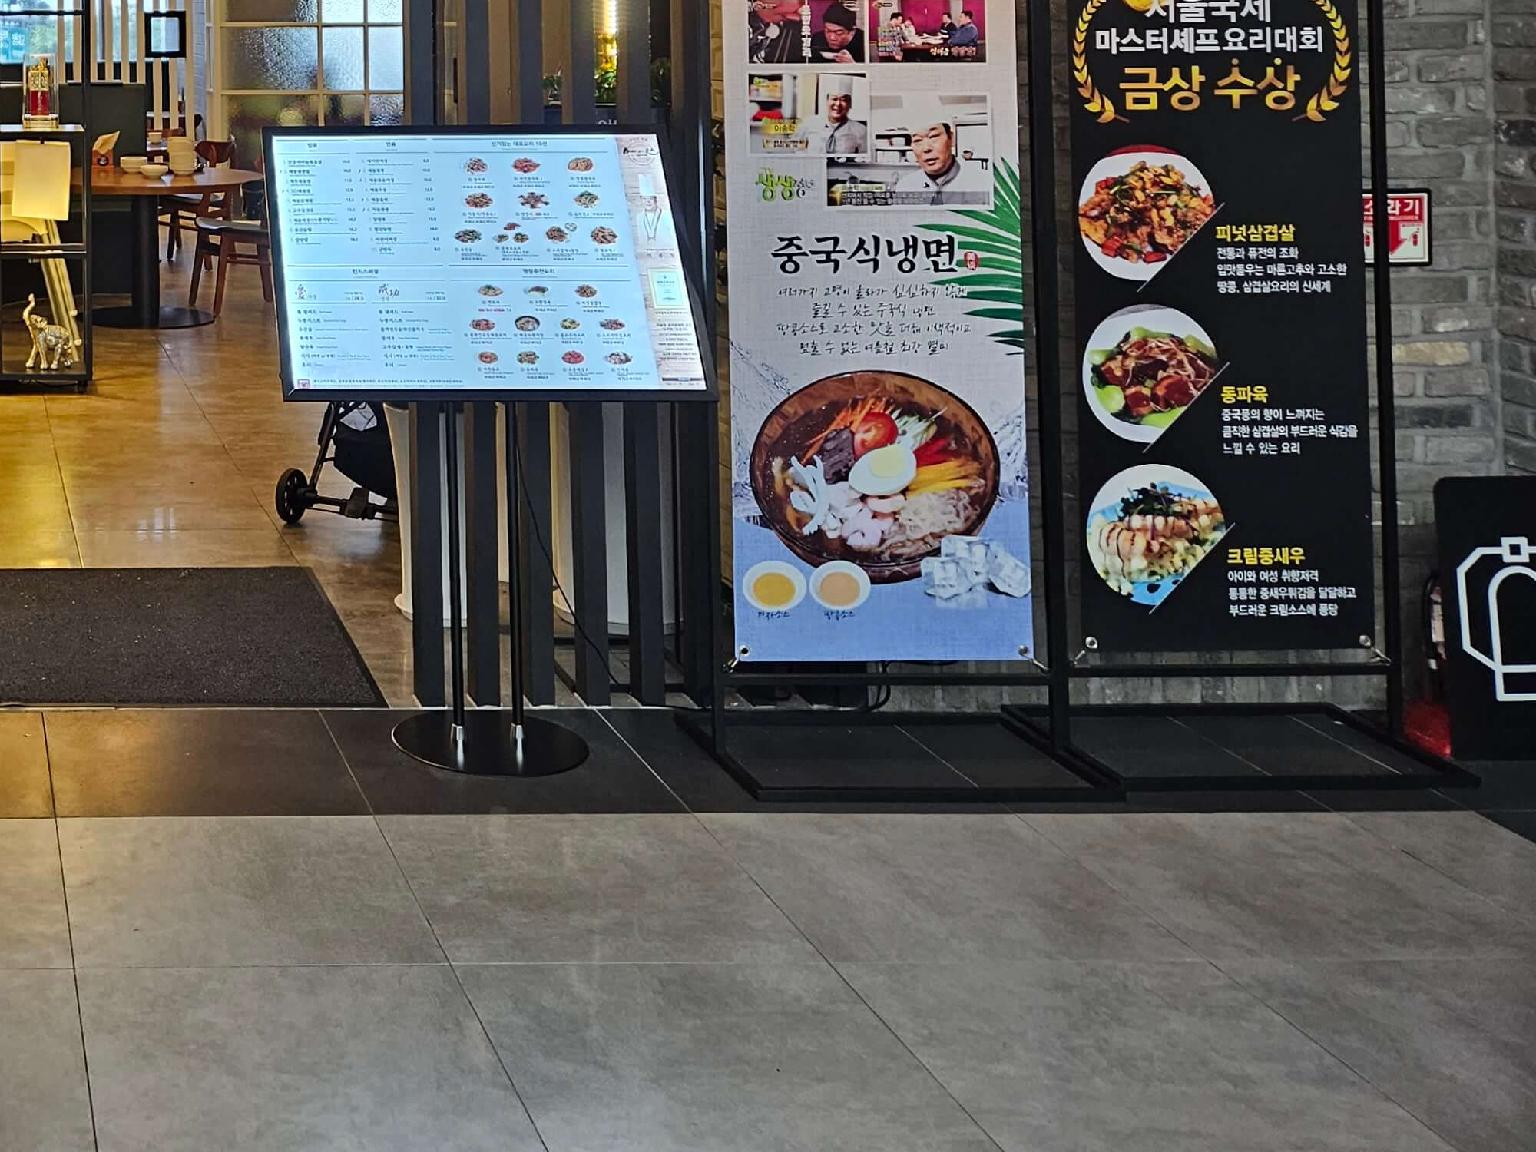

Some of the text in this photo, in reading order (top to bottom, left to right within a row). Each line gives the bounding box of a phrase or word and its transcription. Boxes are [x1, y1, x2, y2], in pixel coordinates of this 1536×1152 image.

[1095, 26, 1323, 55] 마스터셰프요리대회
[1119, 58, 1300, 111] 금상 수상
[1216, 224, 1295, 242] 피넛삼겹살
[771, 234, 958, 274] 중국식냉면
[1217, 247, 1299, 259] 전통과 퓨전의 조화
[1266, 263, 1315, 276] 마른고추와
[1317, 263, 1347, 276] 고소한
[1243, 280, 1299, 293] 삼겹살요리의
[1303, 280, 1331, 293] 신세계
[837, 303, 847, 317] 수
[852, 303, 873, 317] 있는
[913, 305, 936, 318] 냉면
[826, 340, 834, 354] 수
[1221, 385, 1268, 403] 동파육
[1222, 409, 1325, 421] 중국풍의 향이 느껴지는
[1223, 425, 1358, 438] 큼직한 삼겹살의 부드러운 식감을
[1223, 442, 1300, 455] 느낄 수 있는 요리
[1227, 547, 1306, 565] 크림중새우
[1228, 570, 1319, 583] 아이와 여성 취향저격
[1229, 603, 1267, 617] 부드러운
[1270, 603, 1316, 617] 크림소스에
